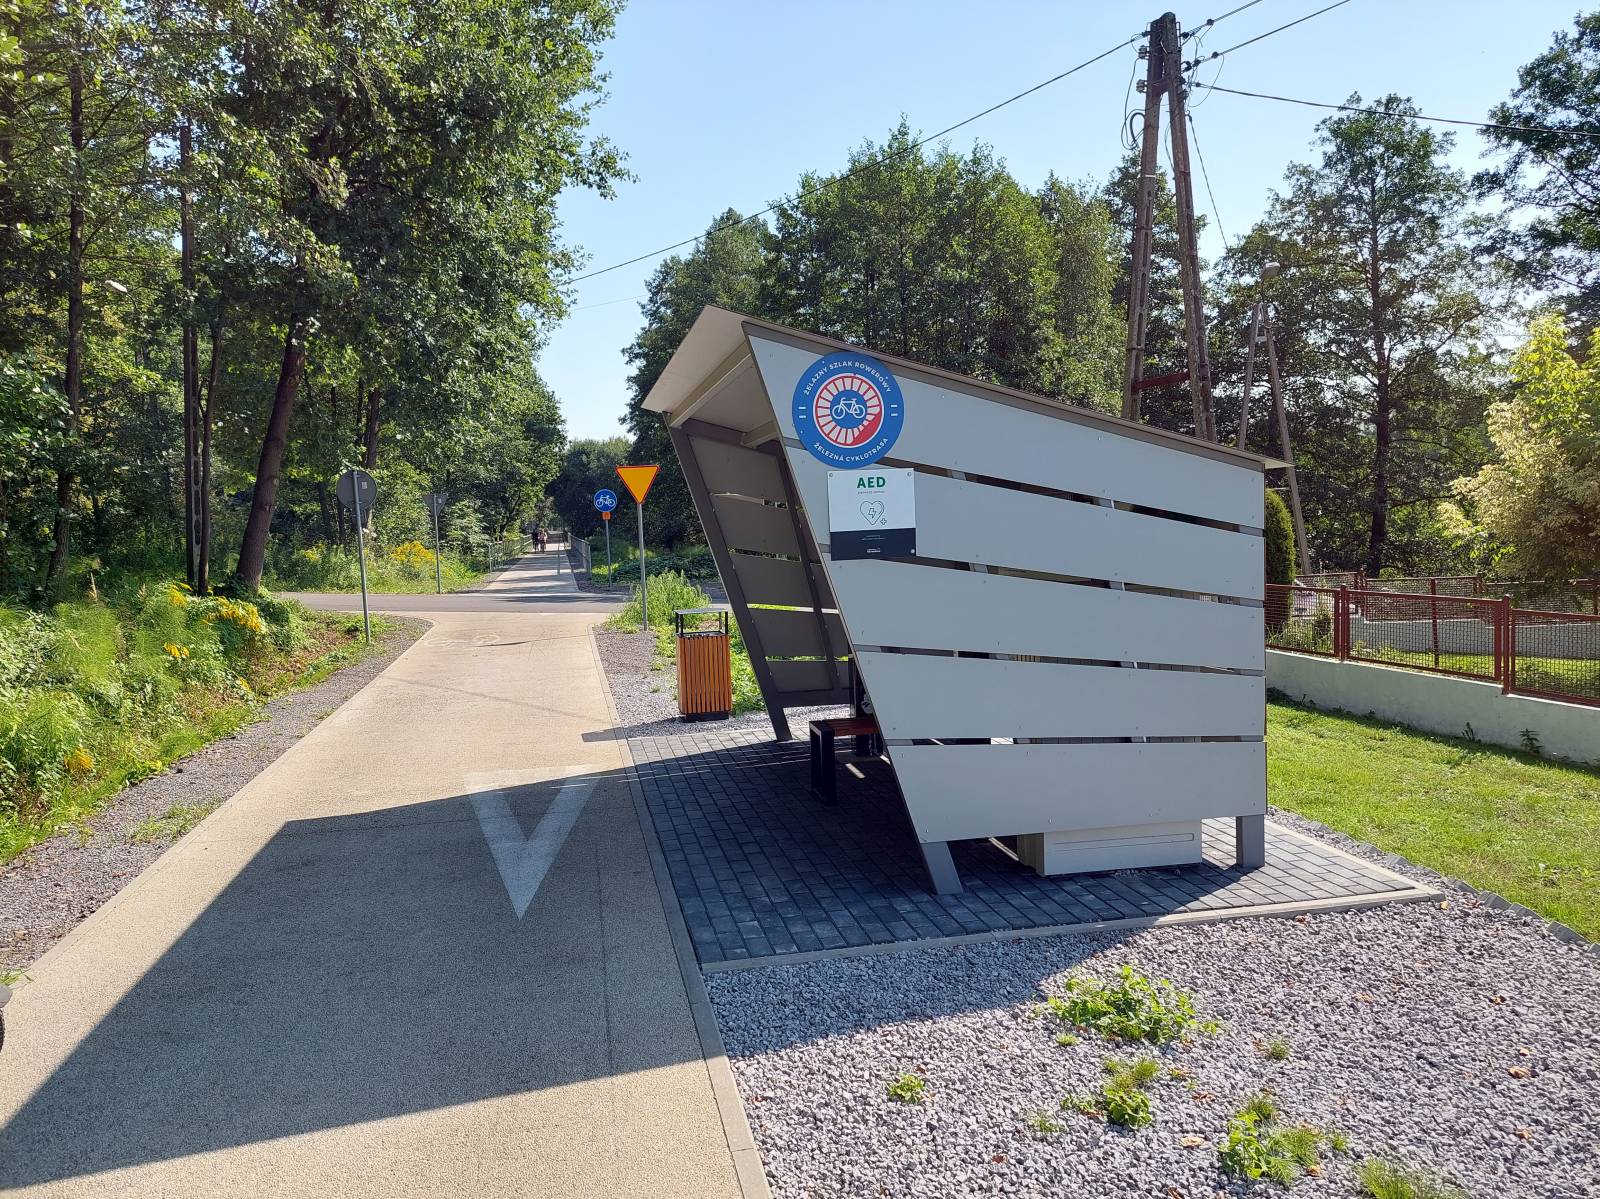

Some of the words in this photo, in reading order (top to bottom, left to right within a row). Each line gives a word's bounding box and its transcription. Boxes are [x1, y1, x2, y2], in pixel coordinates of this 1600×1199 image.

[829, 360, 853, 369] SZLAK
[855, 361, 892, 392] ROWEROWY
[845, 438, 888, 461] CYKLOTRASA
[857, 476, 886, 488] AED
